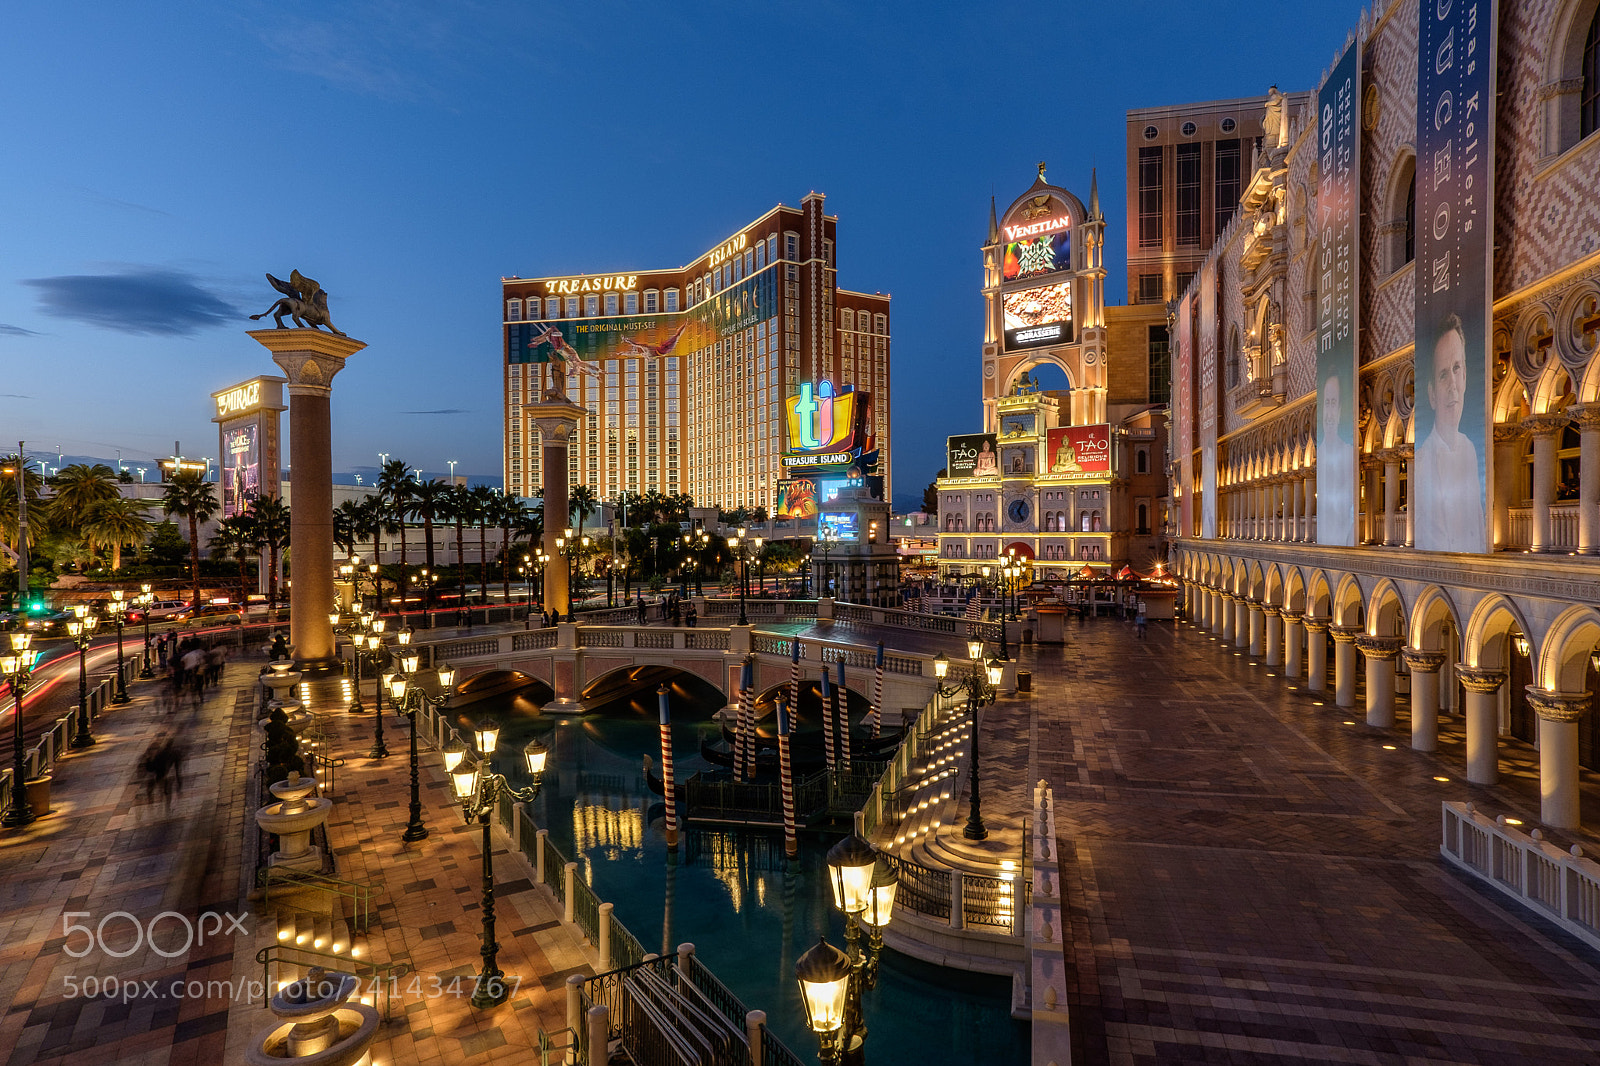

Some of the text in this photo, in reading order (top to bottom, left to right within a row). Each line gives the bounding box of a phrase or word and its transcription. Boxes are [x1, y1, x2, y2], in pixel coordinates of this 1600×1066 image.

[1464, 90, 1479, 234] Keller's
[1337, 194, 1343, 222] TO
[1004, 216, 1069, 241] VENETIAN
[708, 233, 746, 268] ISLAND
[1017, 234, 1056, 264] ROCK
[1017, 253, 1056, 277] AGES
[545, 275, 638, 295] TREASURE
[701, 283, 760, 325] MYSERE
[576, 321, 656, 334] THE ORIGINAL MUST-SEE
[1202, 366, 1214, 390] BOSS
[219, 382, 260, 415] MIRAGE
[950, 448, 978, 460] TAO
[1076, 439, 1109, 451] TAO
[784, 454, 847, 466] TREASURE ISLAND
